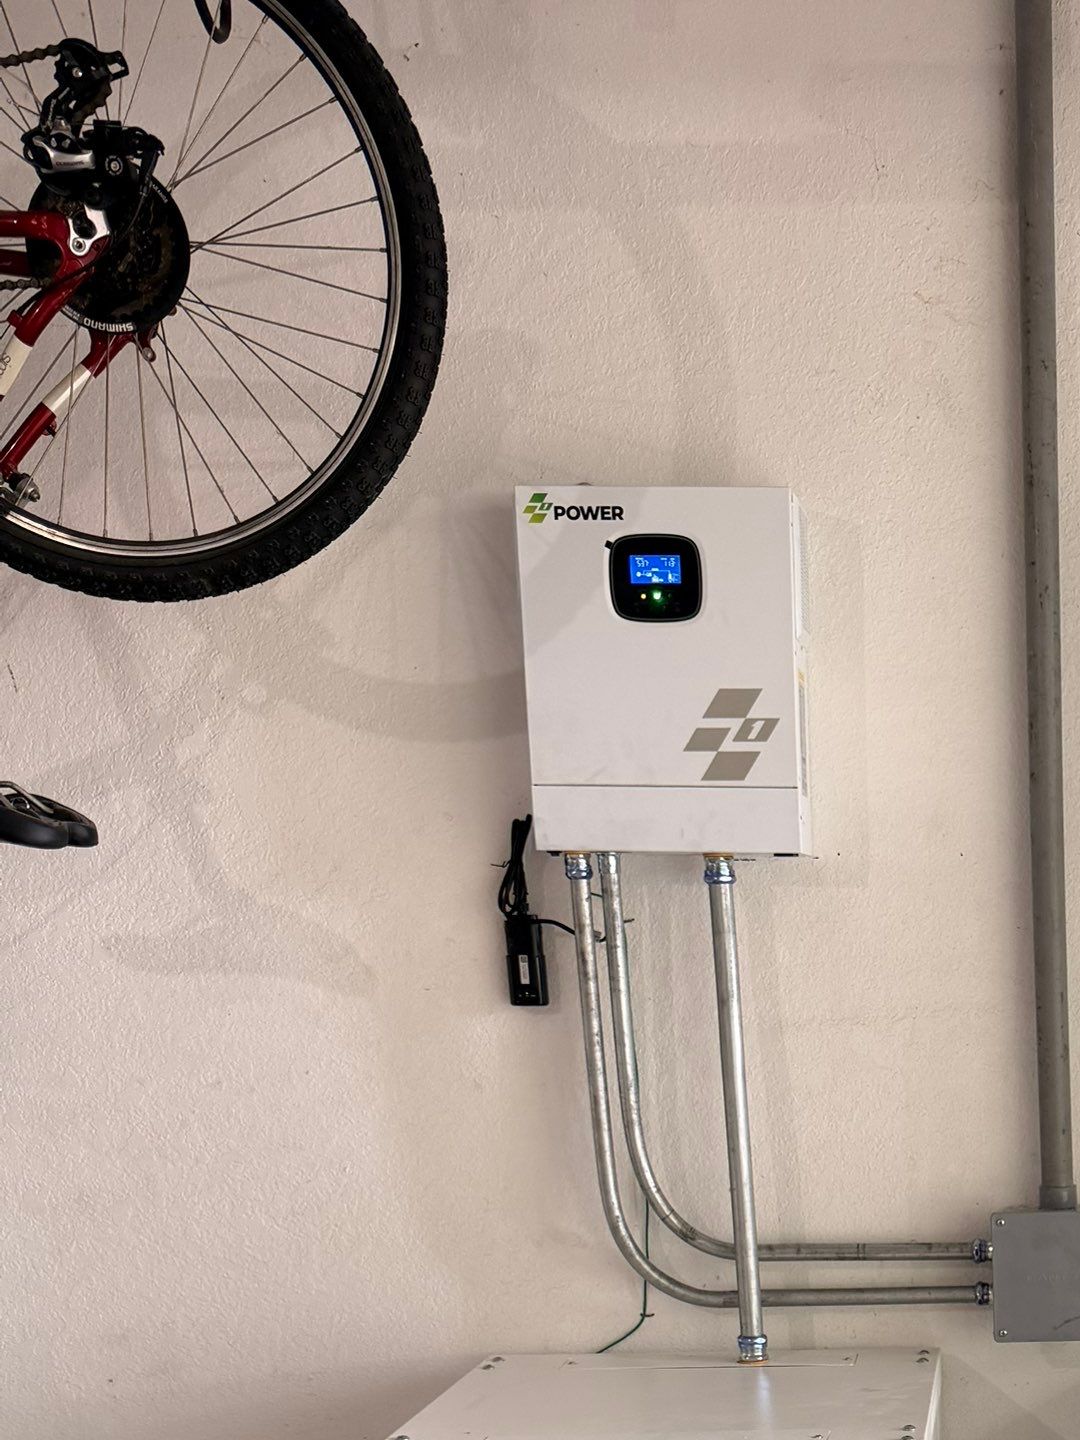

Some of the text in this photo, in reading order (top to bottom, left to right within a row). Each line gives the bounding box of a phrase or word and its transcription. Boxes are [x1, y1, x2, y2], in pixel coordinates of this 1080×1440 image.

[84, 317, 134, 332] SHIMANO
[553, 505, 624, 520] POWER
[747, 720, 766, 740] 1
